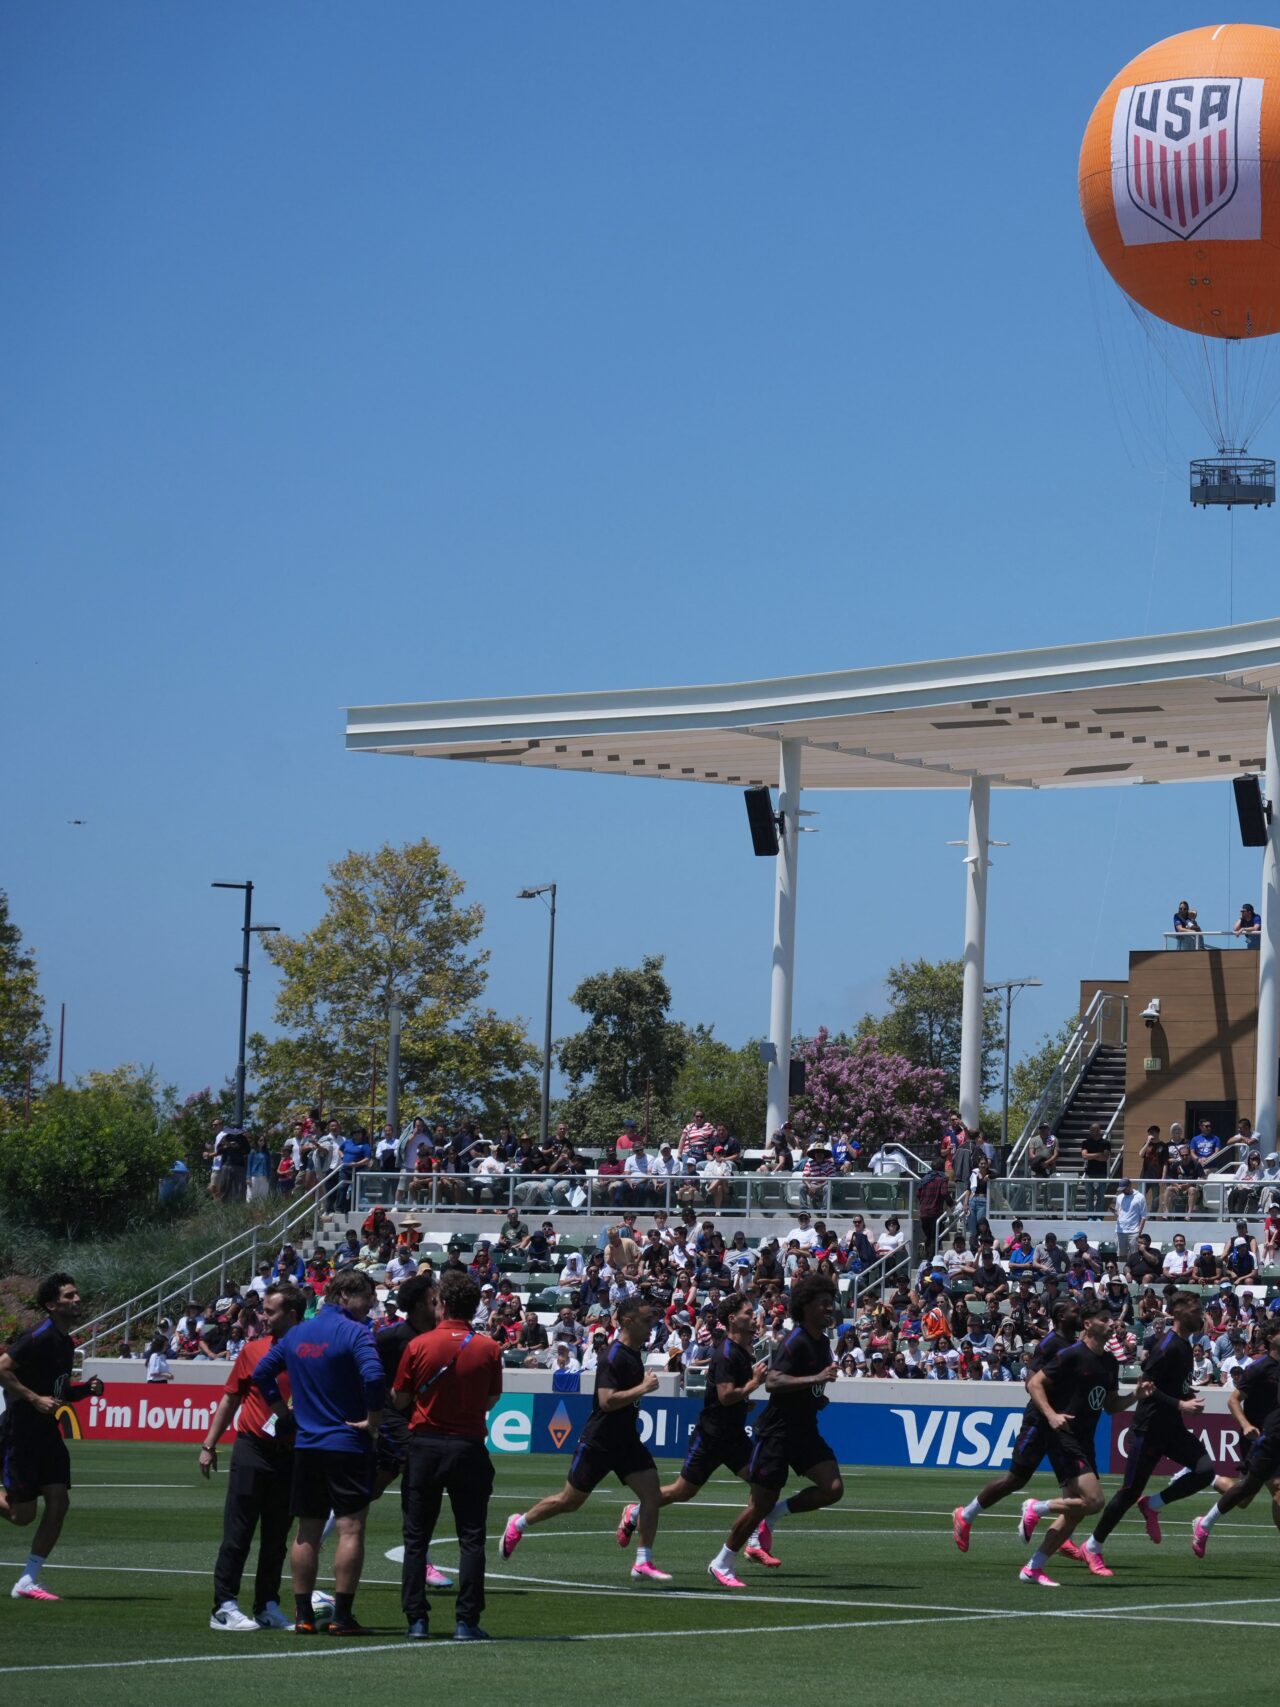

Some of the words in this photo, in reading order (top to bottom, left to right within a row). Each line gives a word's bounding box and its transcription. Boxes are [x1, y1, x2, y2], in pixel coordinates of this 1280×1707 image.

[1134, 85, 1231, 141] USA
[88, 1397, 132, 1428] i'm
[137, 1399, 218, 1430] lovin'
[890, 1408, 1023, 1467] VISA
